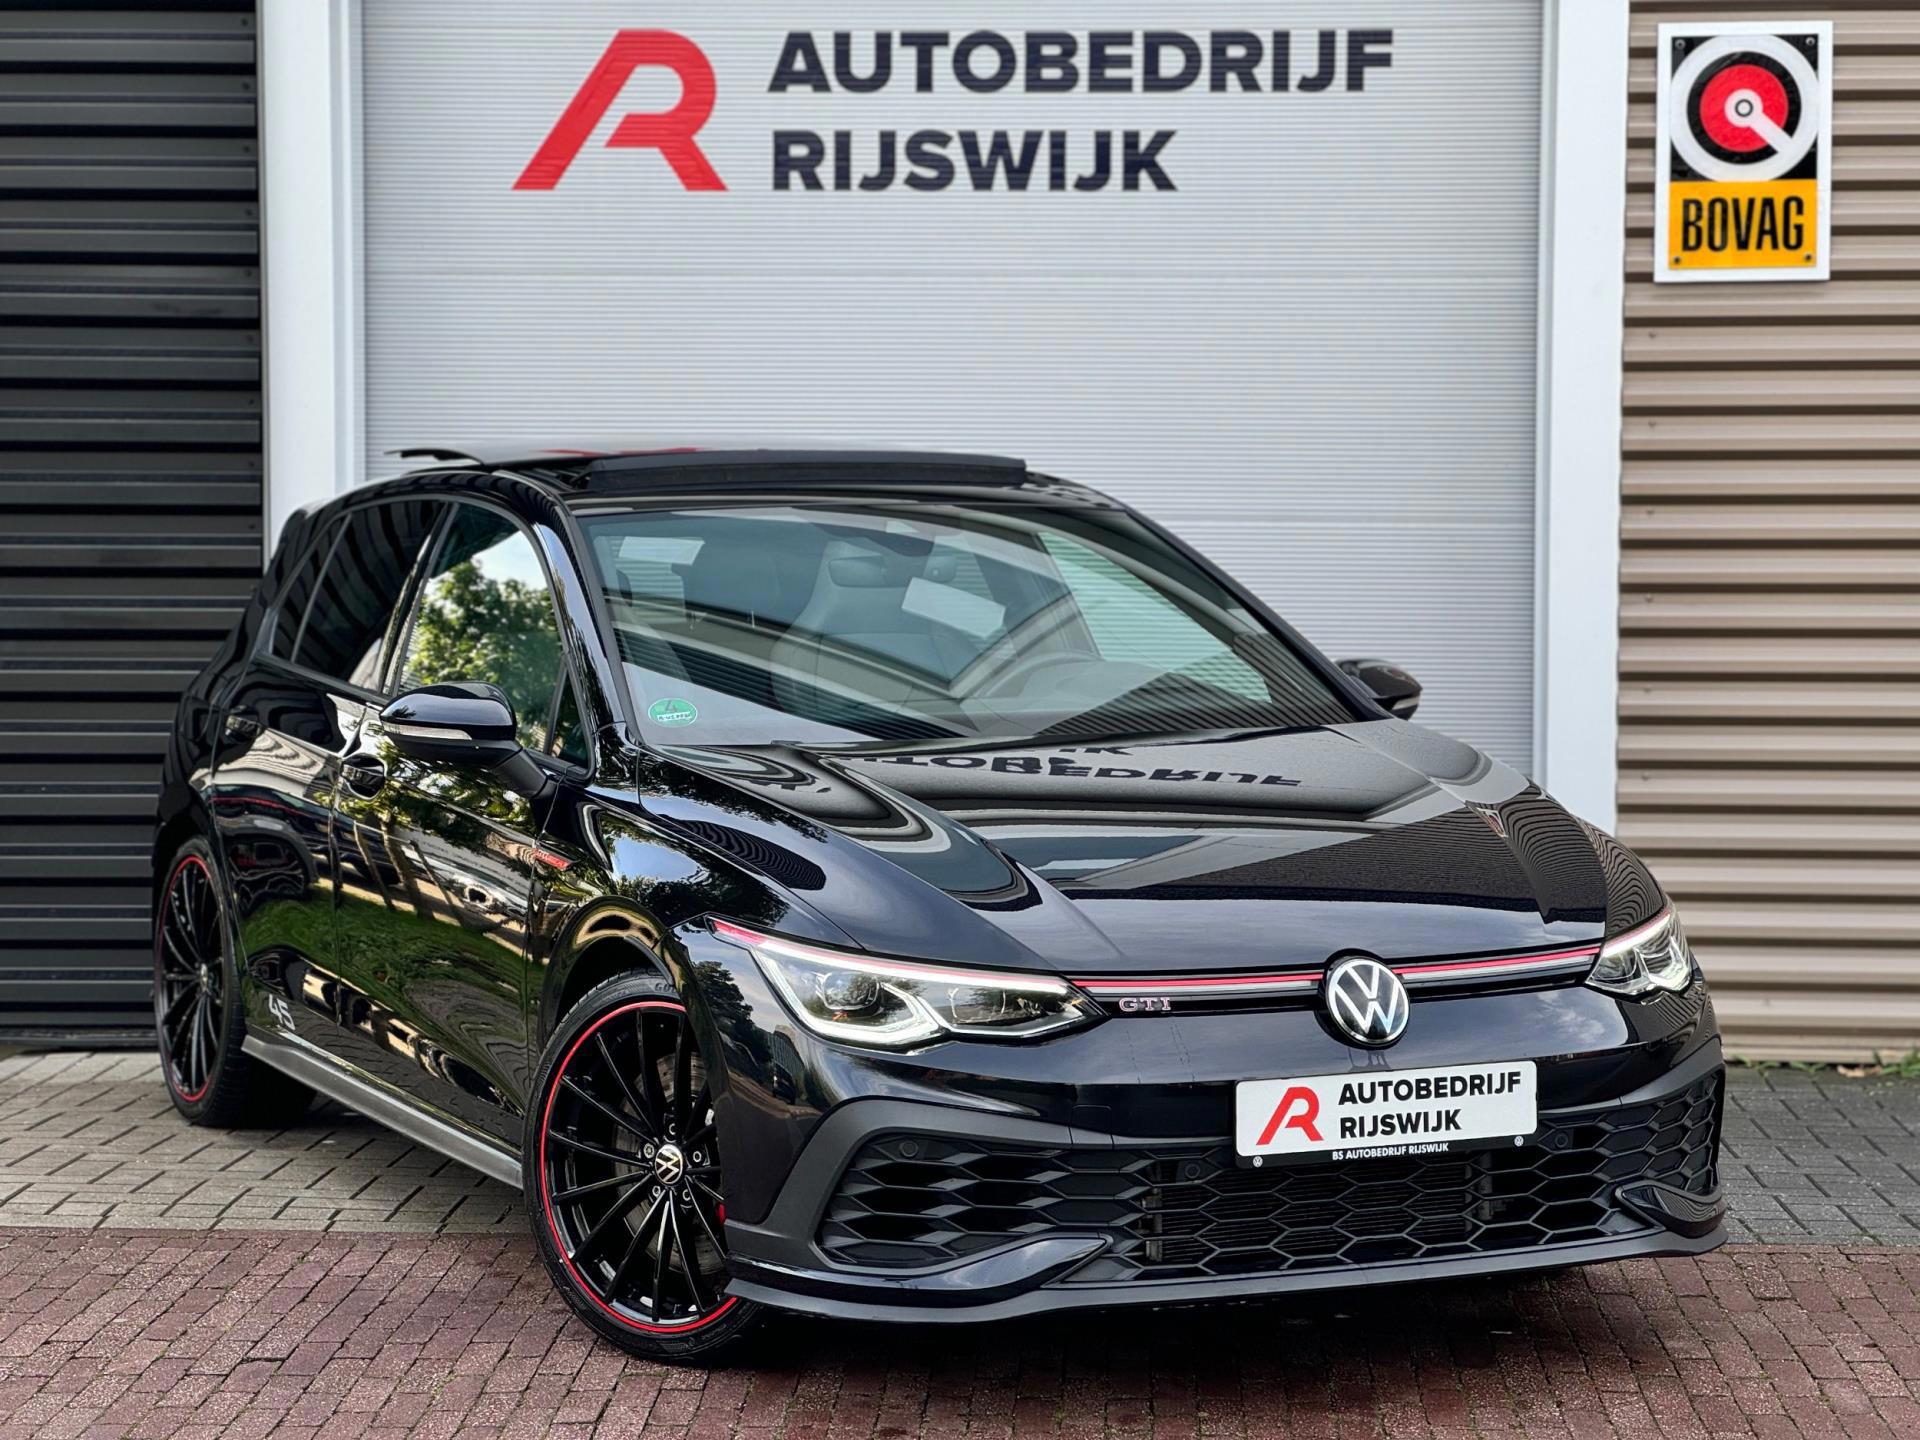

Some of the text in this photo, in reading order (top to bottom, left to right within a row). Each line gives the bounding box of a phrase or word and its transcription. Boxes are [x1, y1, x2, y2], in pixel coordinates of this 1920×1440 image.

[768, 28, 1394, 93] AUTOBEDRIJF
[771, 129, 1179, 191] RIJSWIJK
[1682, 196, 1804, 252] BOVAG
[1119, 997, 1172, 1013] GTI
[1338, 1071, 1521, 1106] AUTOBEDRIJF
[1340, 1109, 1462, 1139] RIJSWIJK
[1332, 1143, 1449, 1160] BS AUTOBEDRIJF RIJSWIJK
